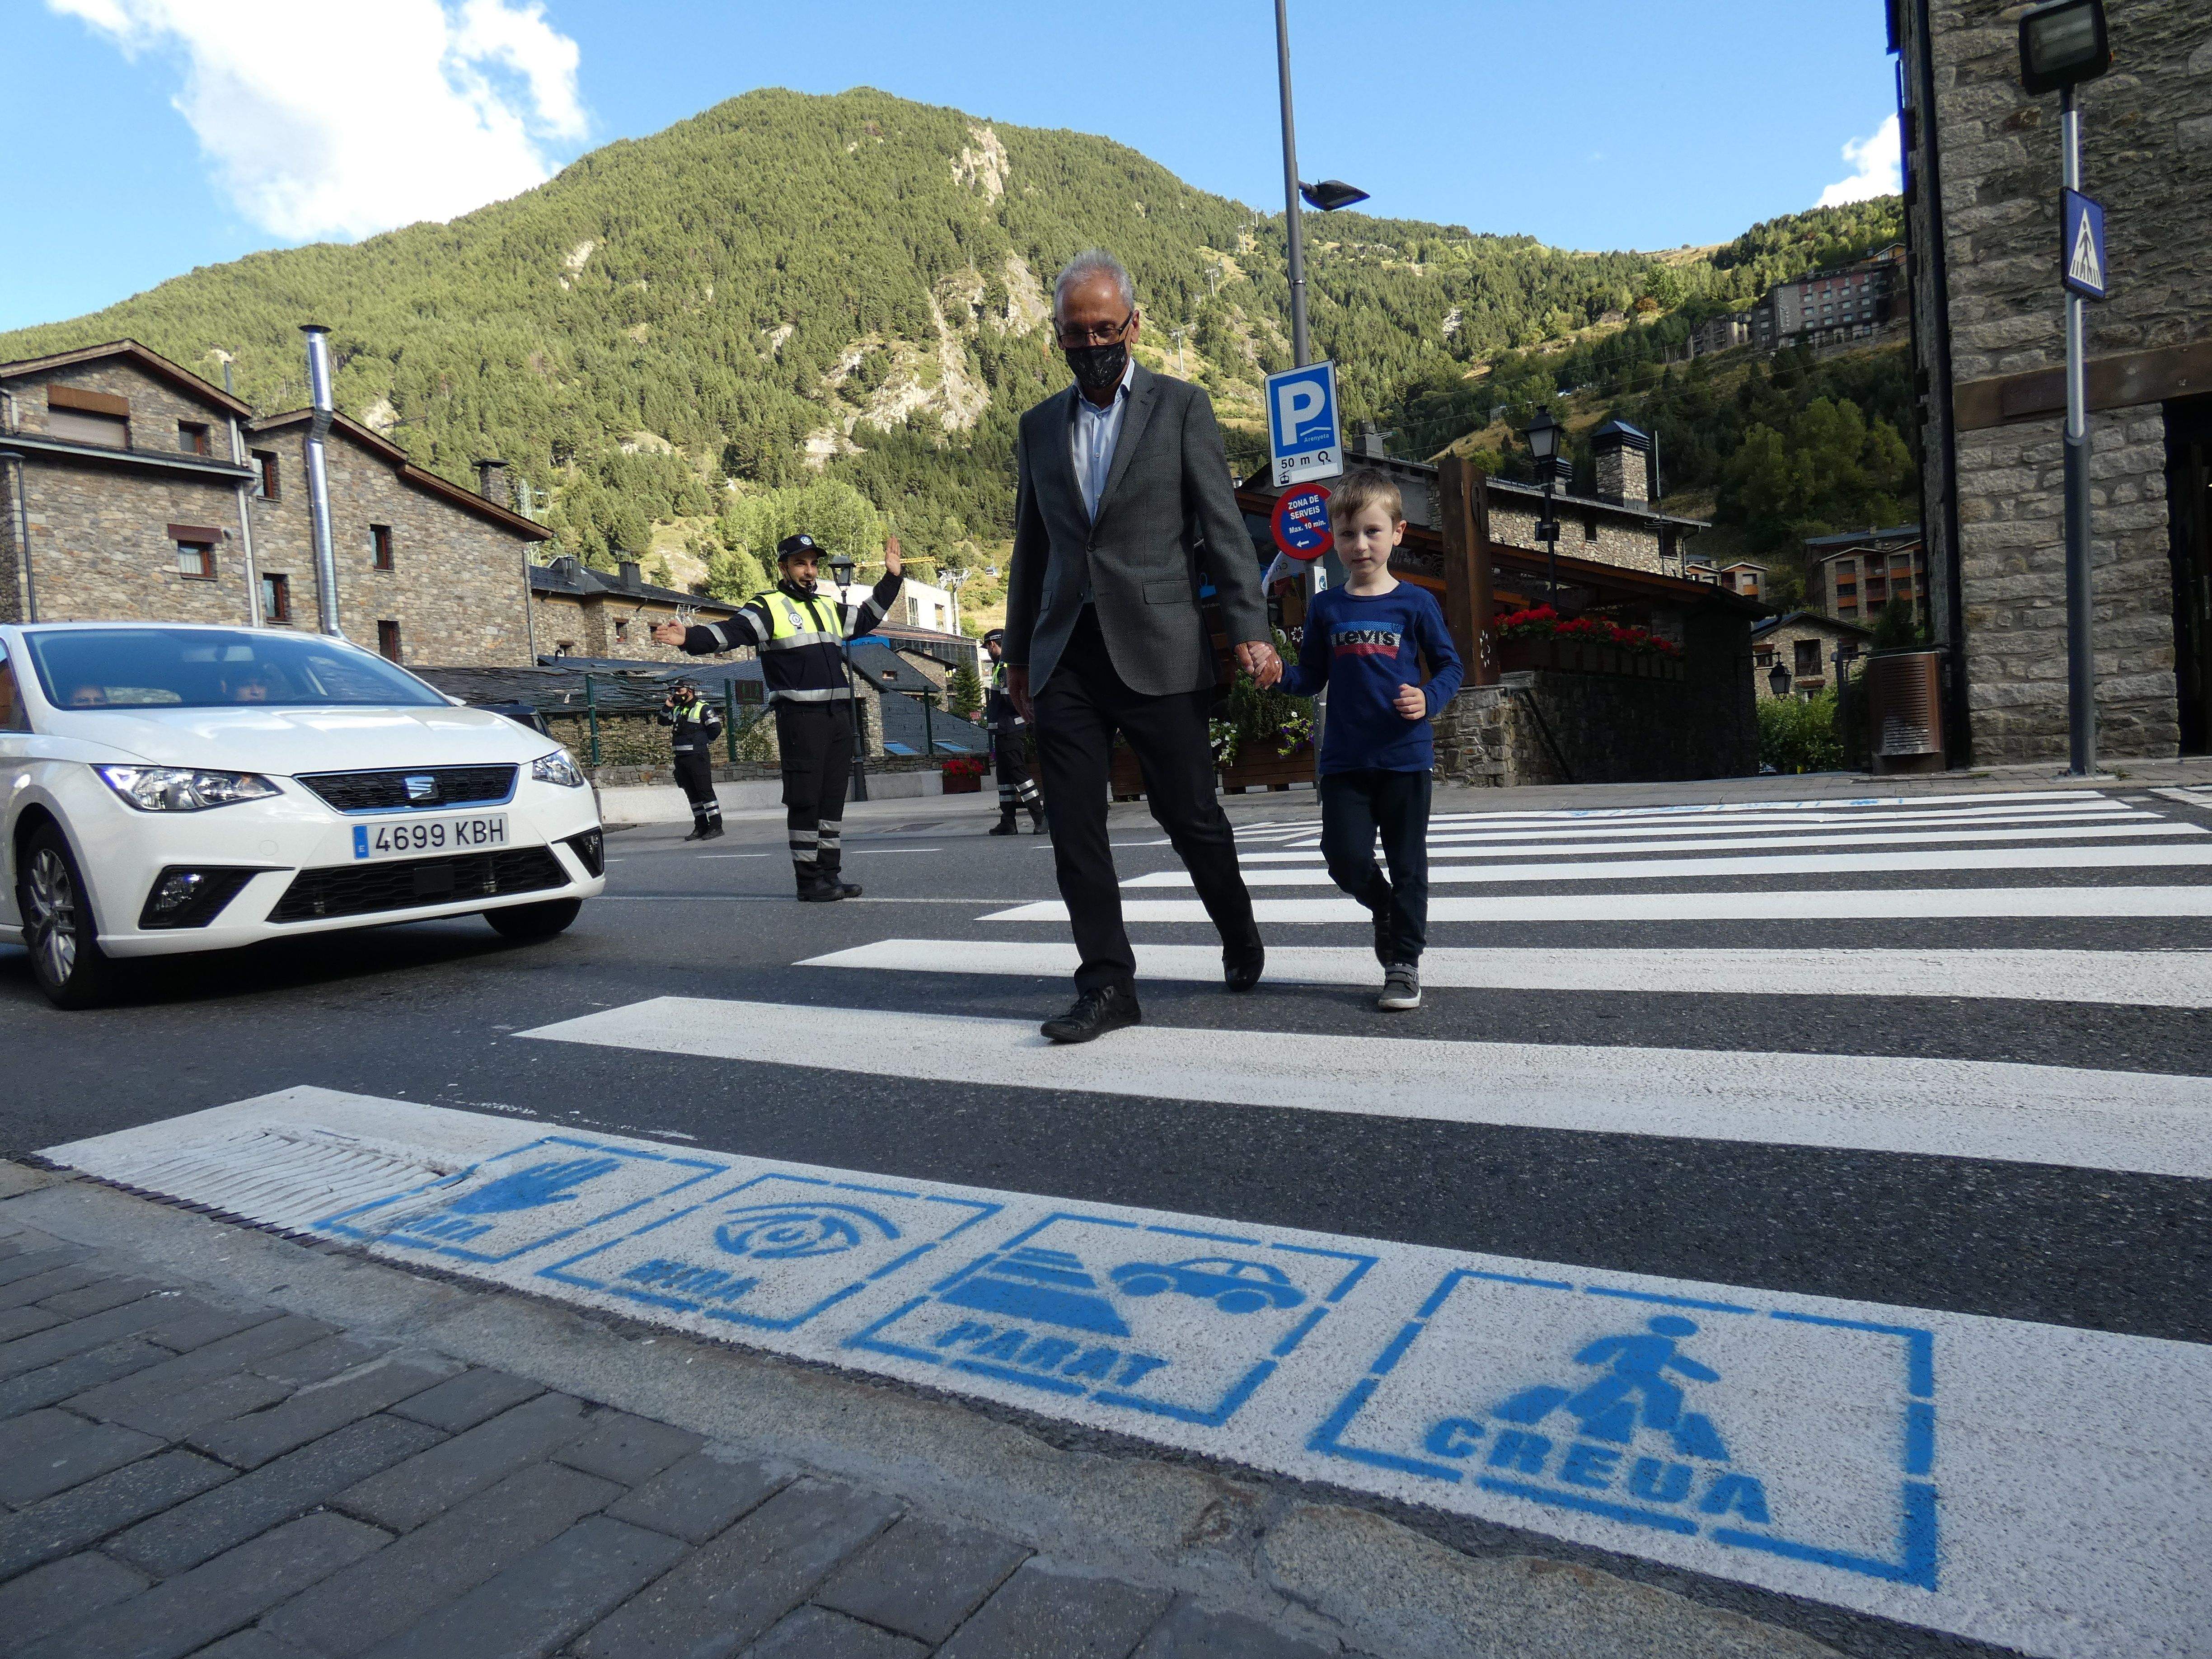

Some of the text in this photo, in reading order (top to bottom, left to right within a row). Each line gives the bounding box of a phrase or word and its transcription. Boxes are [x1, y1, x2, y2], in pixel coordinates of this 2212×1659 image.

[1278, 380, 1326, 446] P
[1304, 433, 1330, 443] Arenyeta
[1281, 456, 1311, 469] 50 m
[1288, 494, 1319, 510] ZONA DE
[1290, 505, 1320, 520] SERVEIS
[1304, 521, 1312, 530] 10
[1313, 520, 1326, 528] min.
[375, 819, 503, 852] 4699 KBH
[1425, 1416, 1770, 1524] CREUA
